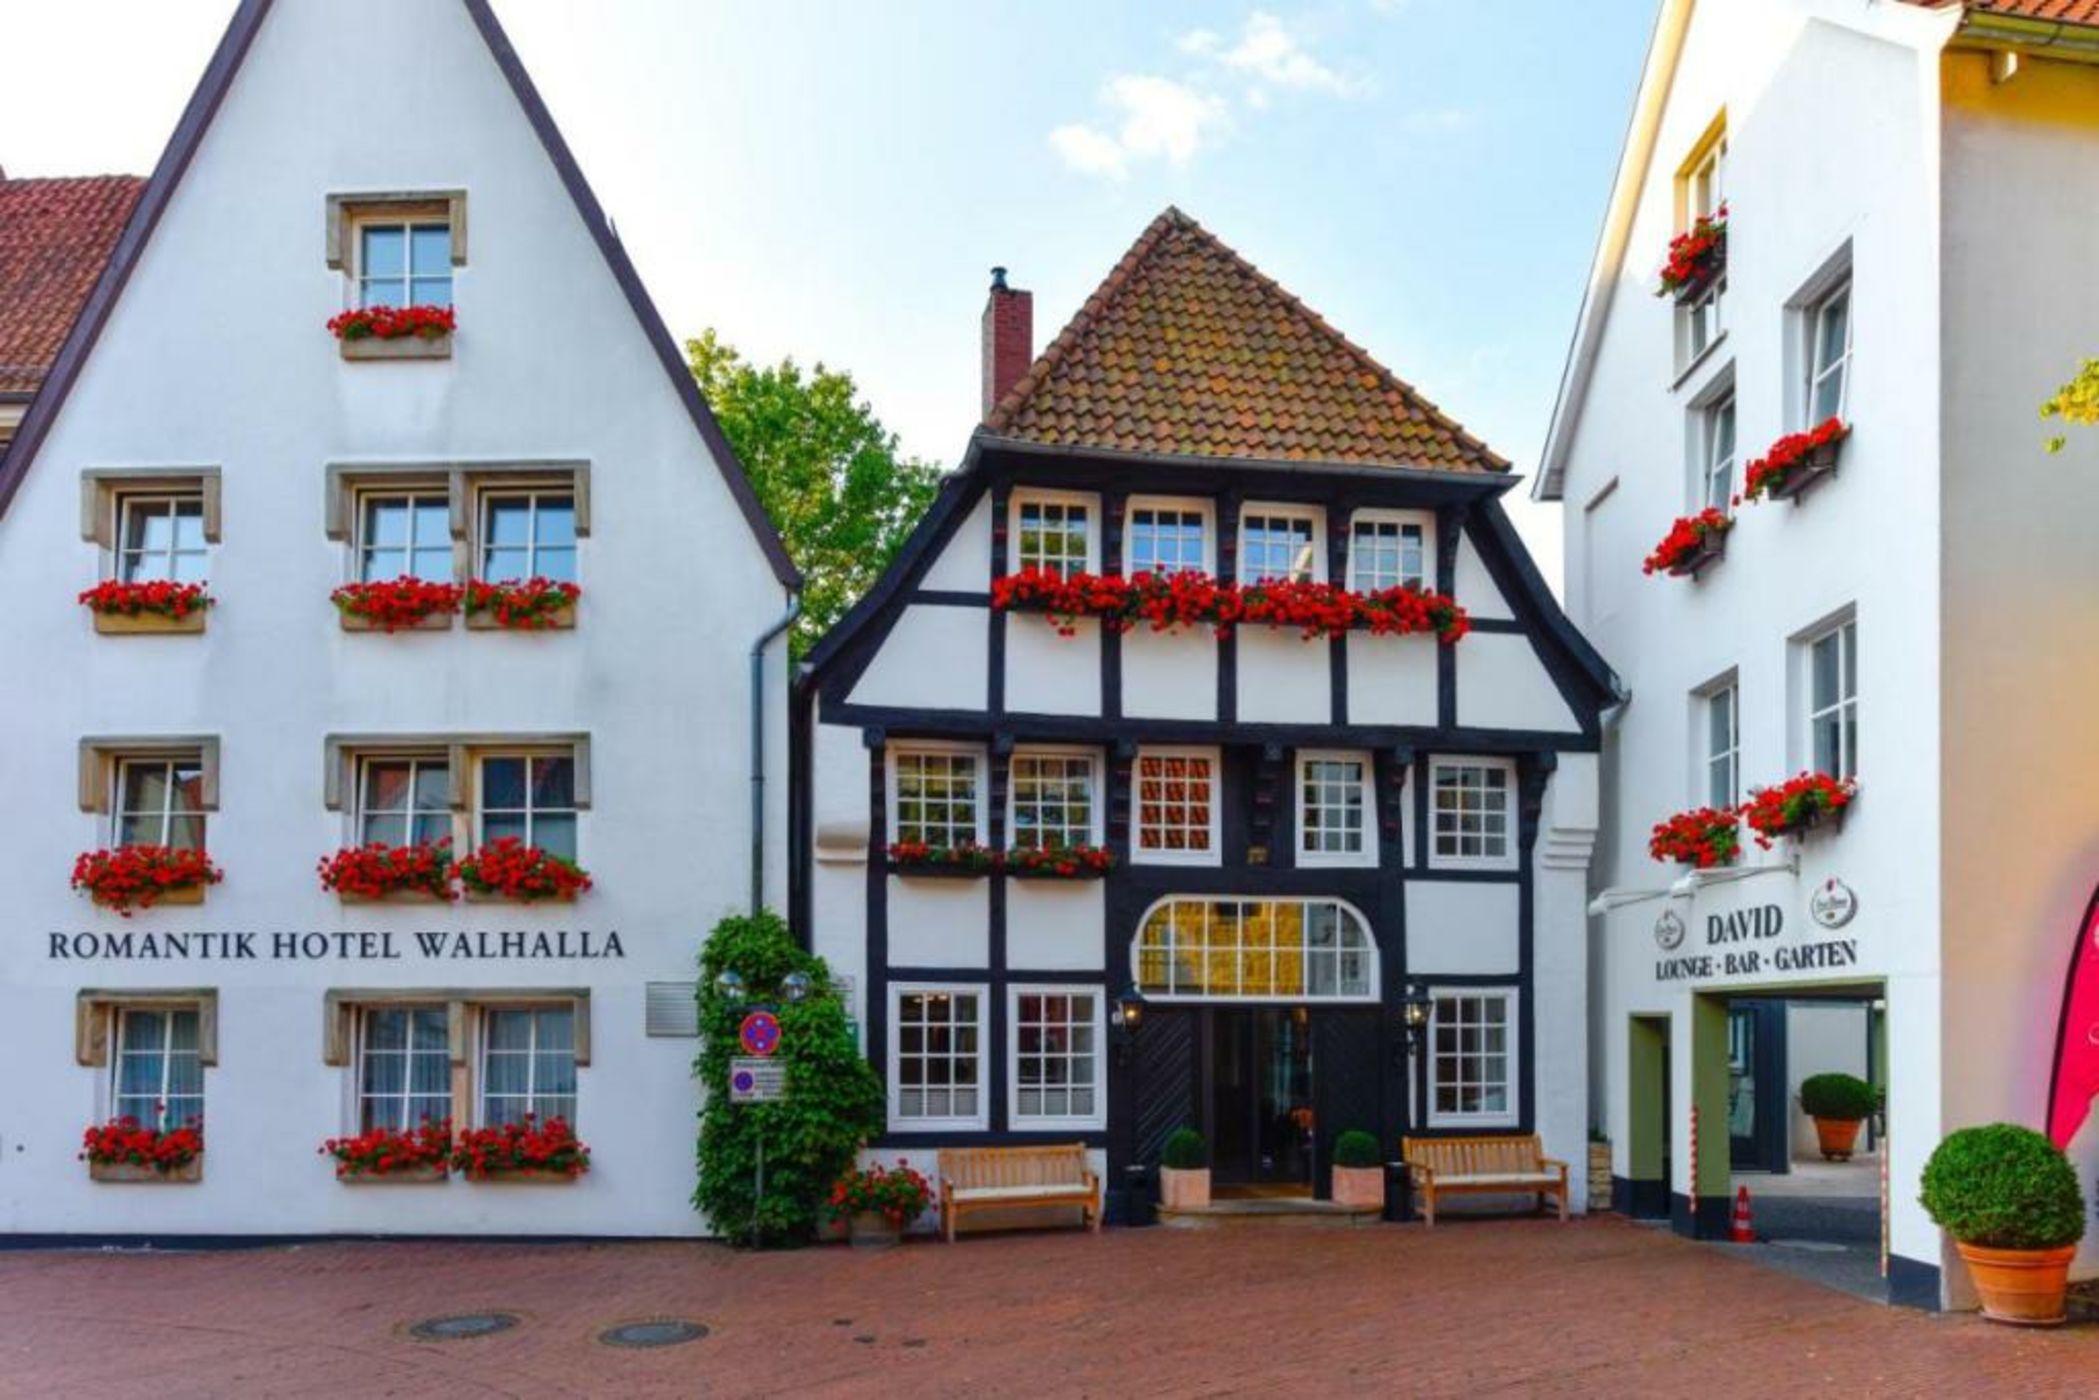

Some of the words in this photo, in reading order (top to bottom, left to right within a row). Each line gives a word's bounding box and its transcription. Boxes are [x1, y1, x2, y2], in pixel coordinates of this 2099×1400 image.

[48, 932, 257, 959] ROMANTIK
[272, 931, 400, 959] HOTEL
[414, 931, 625, 959] WALHALLA
[1707, 904, 1784, 945] DAVID
[1655, 957, 1713, 981] LOUNGE
[1725, 951, 1760, 975] BAR
[1775, 939, 1857, 971] GARTEN
